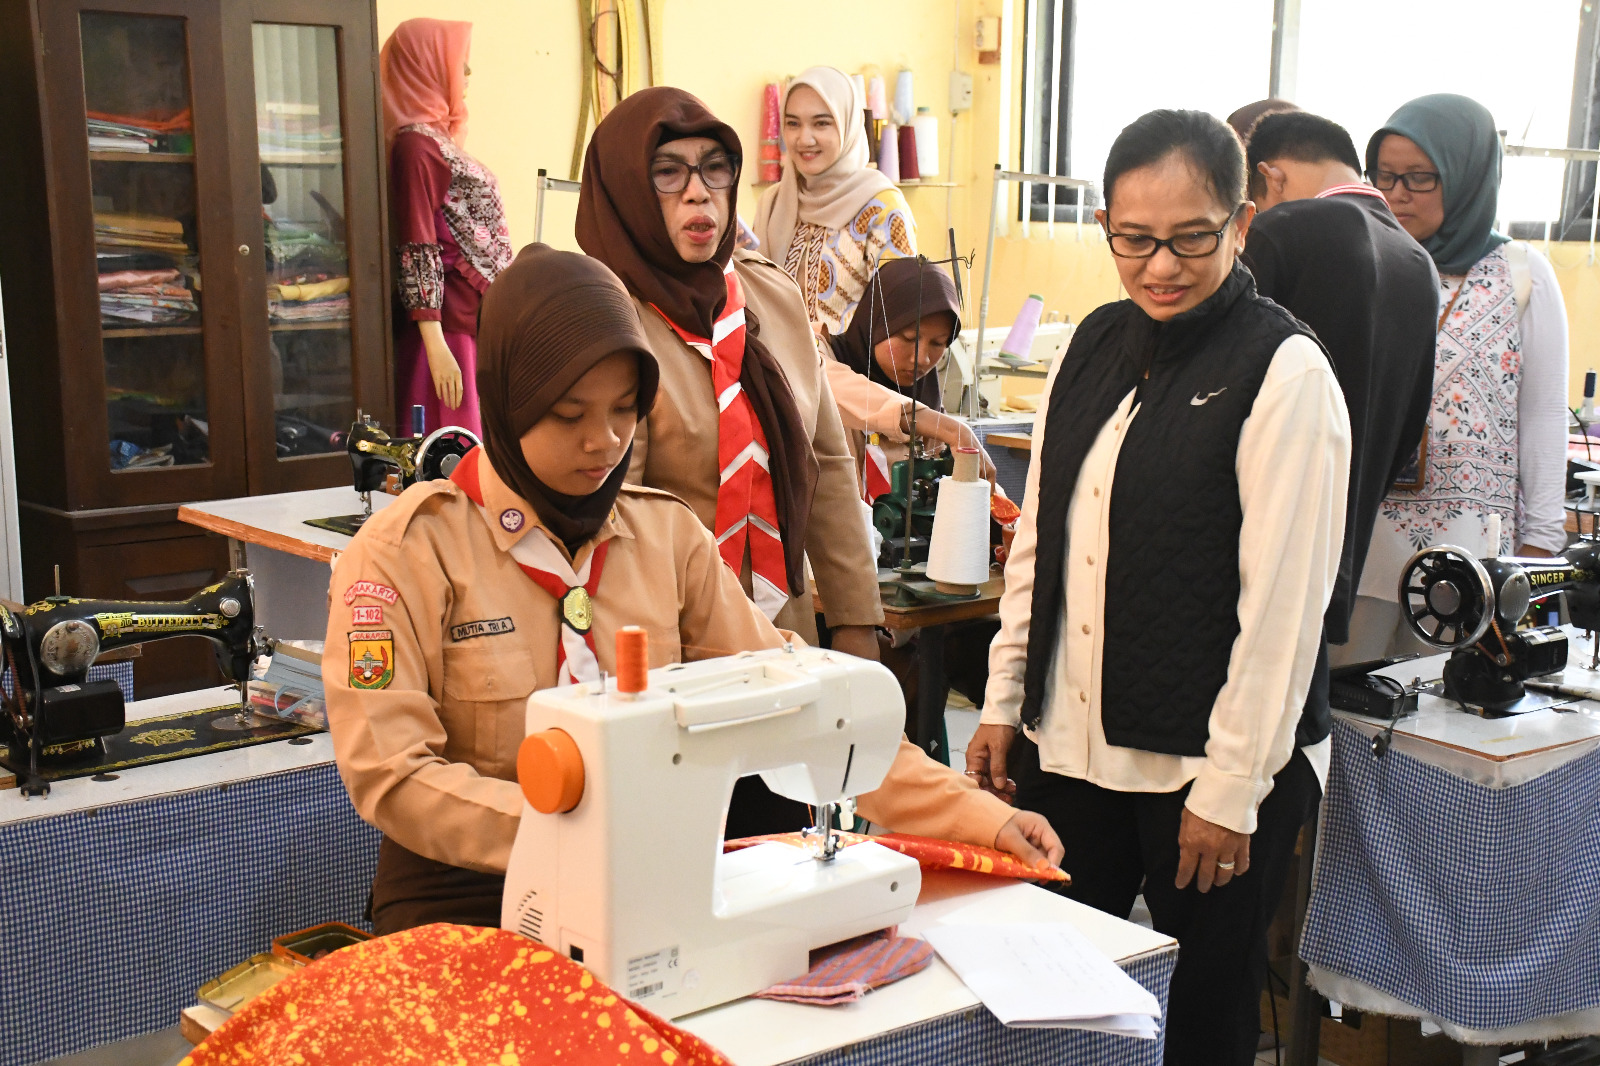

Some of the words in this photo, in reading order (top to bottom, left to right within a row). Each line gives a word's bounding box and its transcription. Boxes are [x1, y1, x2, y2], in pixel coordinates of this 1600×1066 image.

[1530, 572, 1565, 585] SINGER
[137, 616, 205, 628] BUTTERFLY
[457, 623, 485, 637] MUTIA
[488, 622, 500, 632] TRI
[501, 621, 508, 631] A
